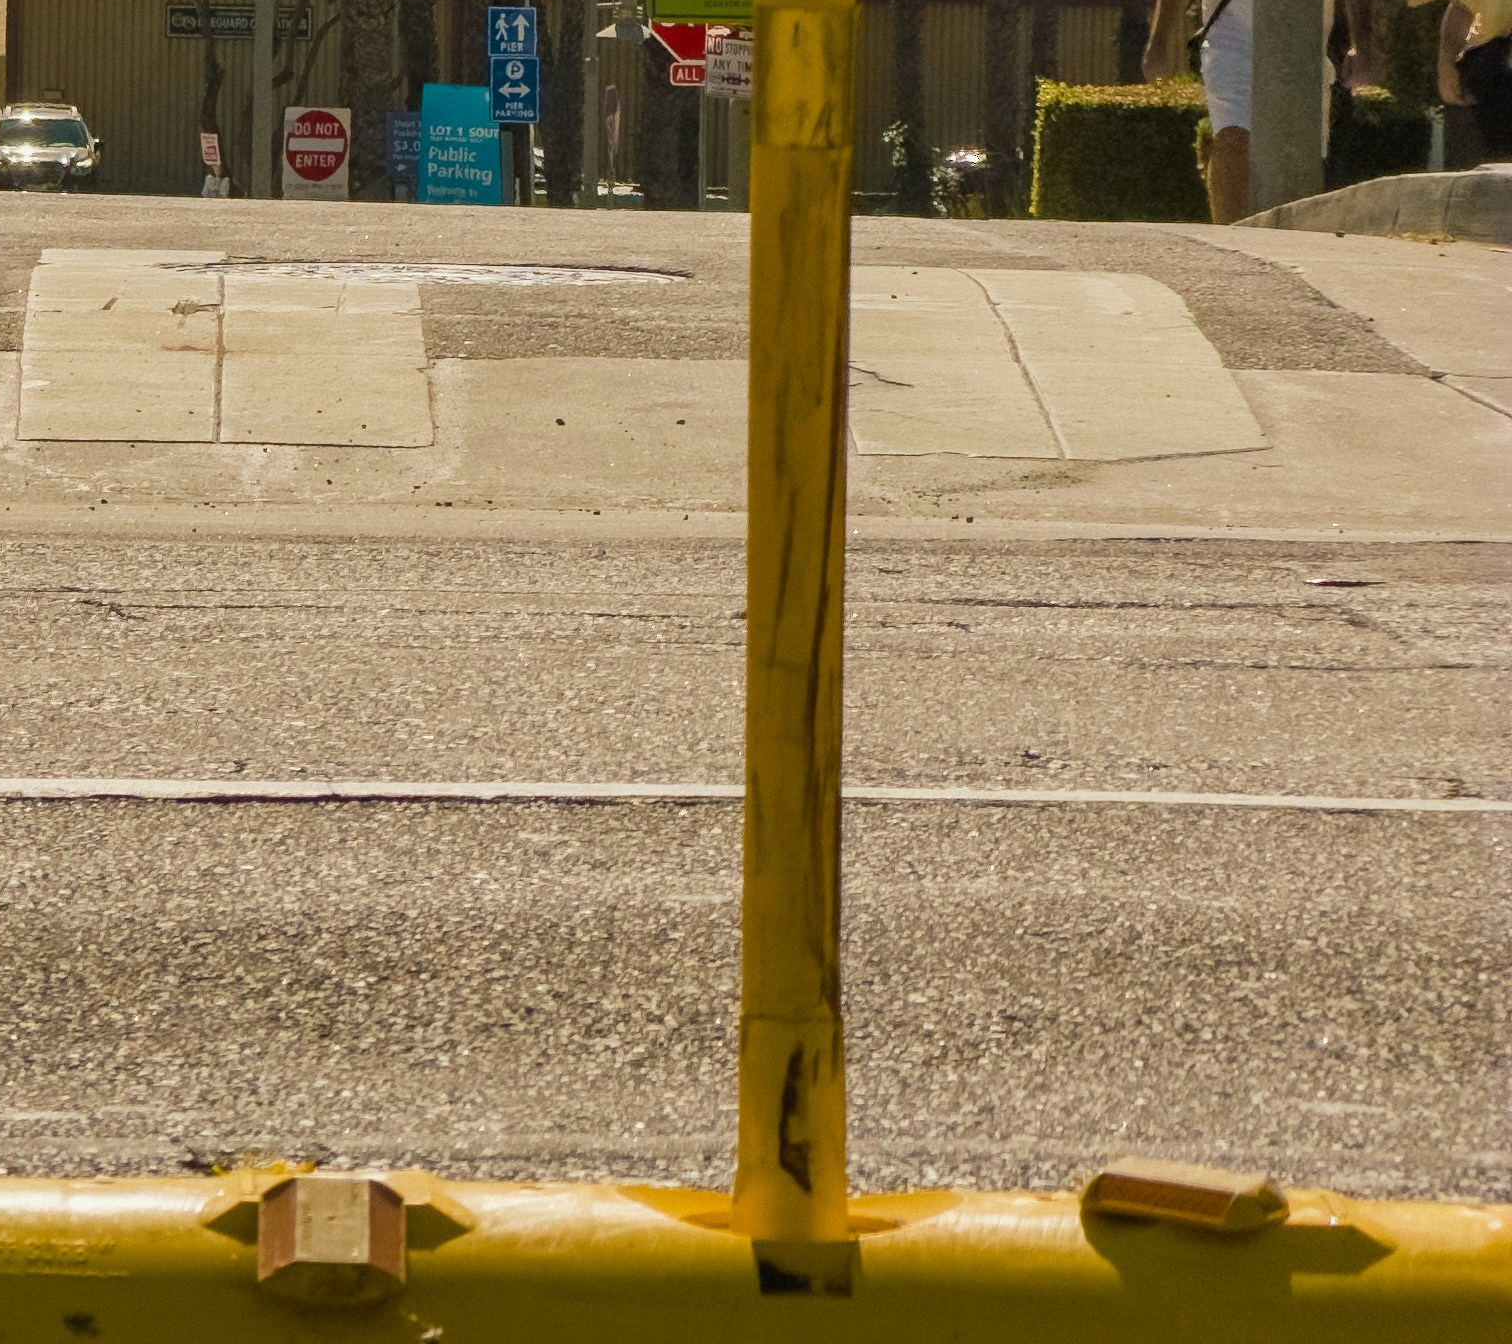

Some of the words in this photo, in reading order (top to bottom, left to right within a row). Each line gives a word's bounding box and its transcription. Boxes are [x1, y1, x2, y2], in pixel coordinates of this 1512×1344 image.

[197, 16, 248, 30] LEGUARD
[500, 42, 524, 52] PIER
[707, 37, 722, 53] NO
[713, 58, 731, 70] ANY
[676, 68, 700, 81] ALL
[505, 102, 524, 110] PIER
[495, 110, 535, 118] PARKING
[295, 122, 312, 136] DO
[315, 122, 340, 136] NOT
[429, 125, 453, 136] LOT
[456, 126, 464, 136] 1
[295, 152, 336, 169] ENTER
[428, 145, 477, 163] Public
[427, 162, 493, 186] Parking
